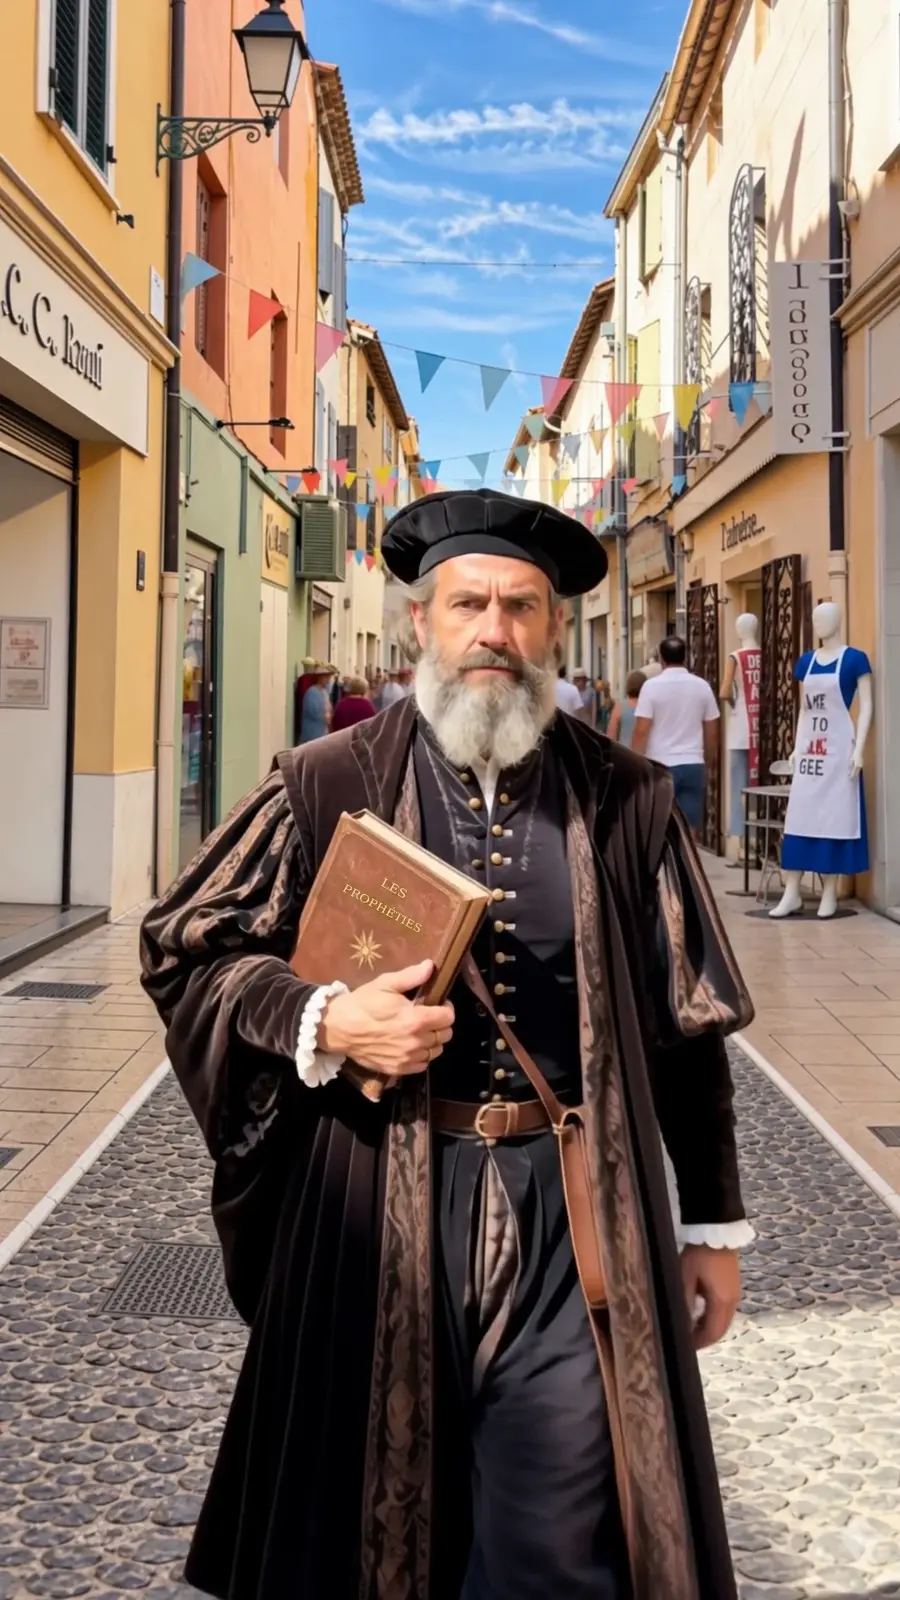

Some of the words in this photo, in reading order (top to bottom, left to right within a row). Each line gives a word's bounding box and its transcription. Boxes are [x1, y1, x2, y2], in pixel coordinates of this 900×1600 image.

[812, 717, 828, 732] TO
[799, 758, 824, 776] GEE
[380, 877, 408, 899] LES
